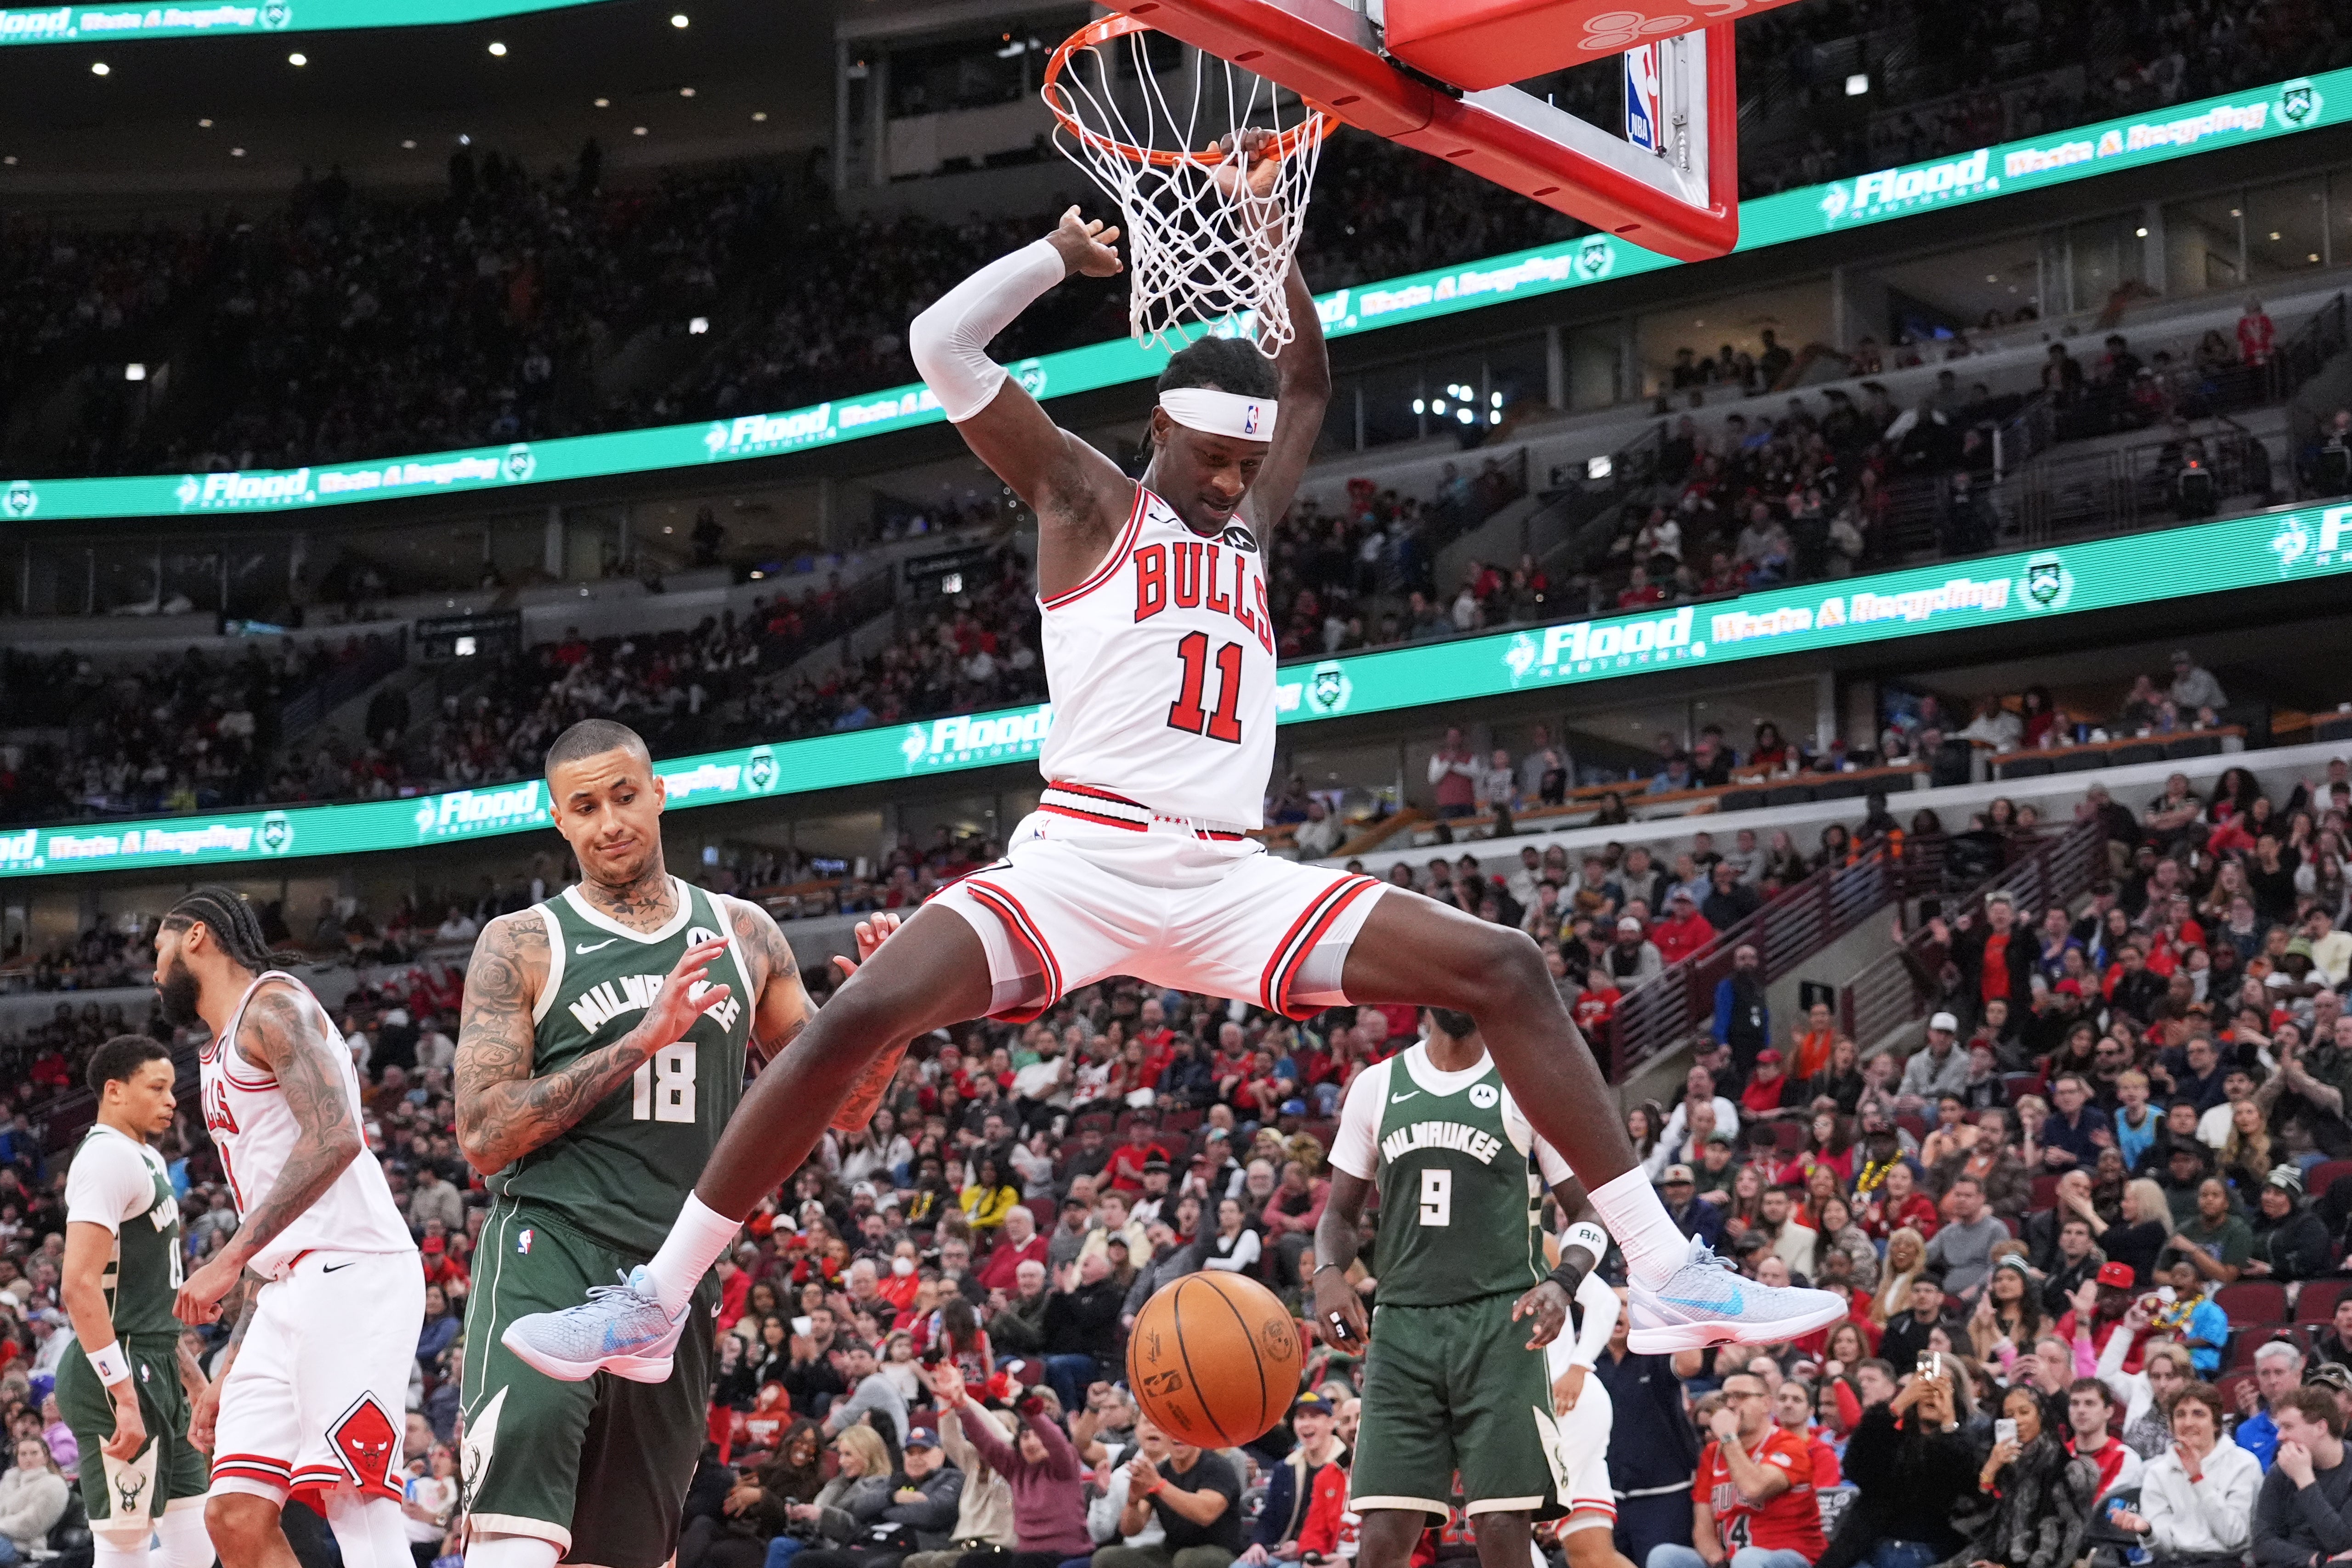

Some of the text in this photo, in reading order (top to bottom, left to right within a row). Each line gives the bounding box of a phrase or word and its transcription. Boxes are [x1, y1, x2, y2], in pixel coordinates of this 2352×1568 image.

[1631, 112, 1648, 142] NBA
[2097, 130, 2124, 158] &
[2126, 102, 2269, 152] Recycling
[1133, 542, 1273, 657] BULLS
[1711, 607, 1814, 644] Waste
[1815, 597, 1847, 629] &
[1849, 577, 2012, 623] Recycling
[1167, 630, 1243, 745] 11
[568, 974, 741, 1035] MILWAKEE
[633, 1042, 697, 1123] 18
[1381, 1121, 1502, 1166] MILWAUKEE
[1419, 1169, 1452, 1226] 9
